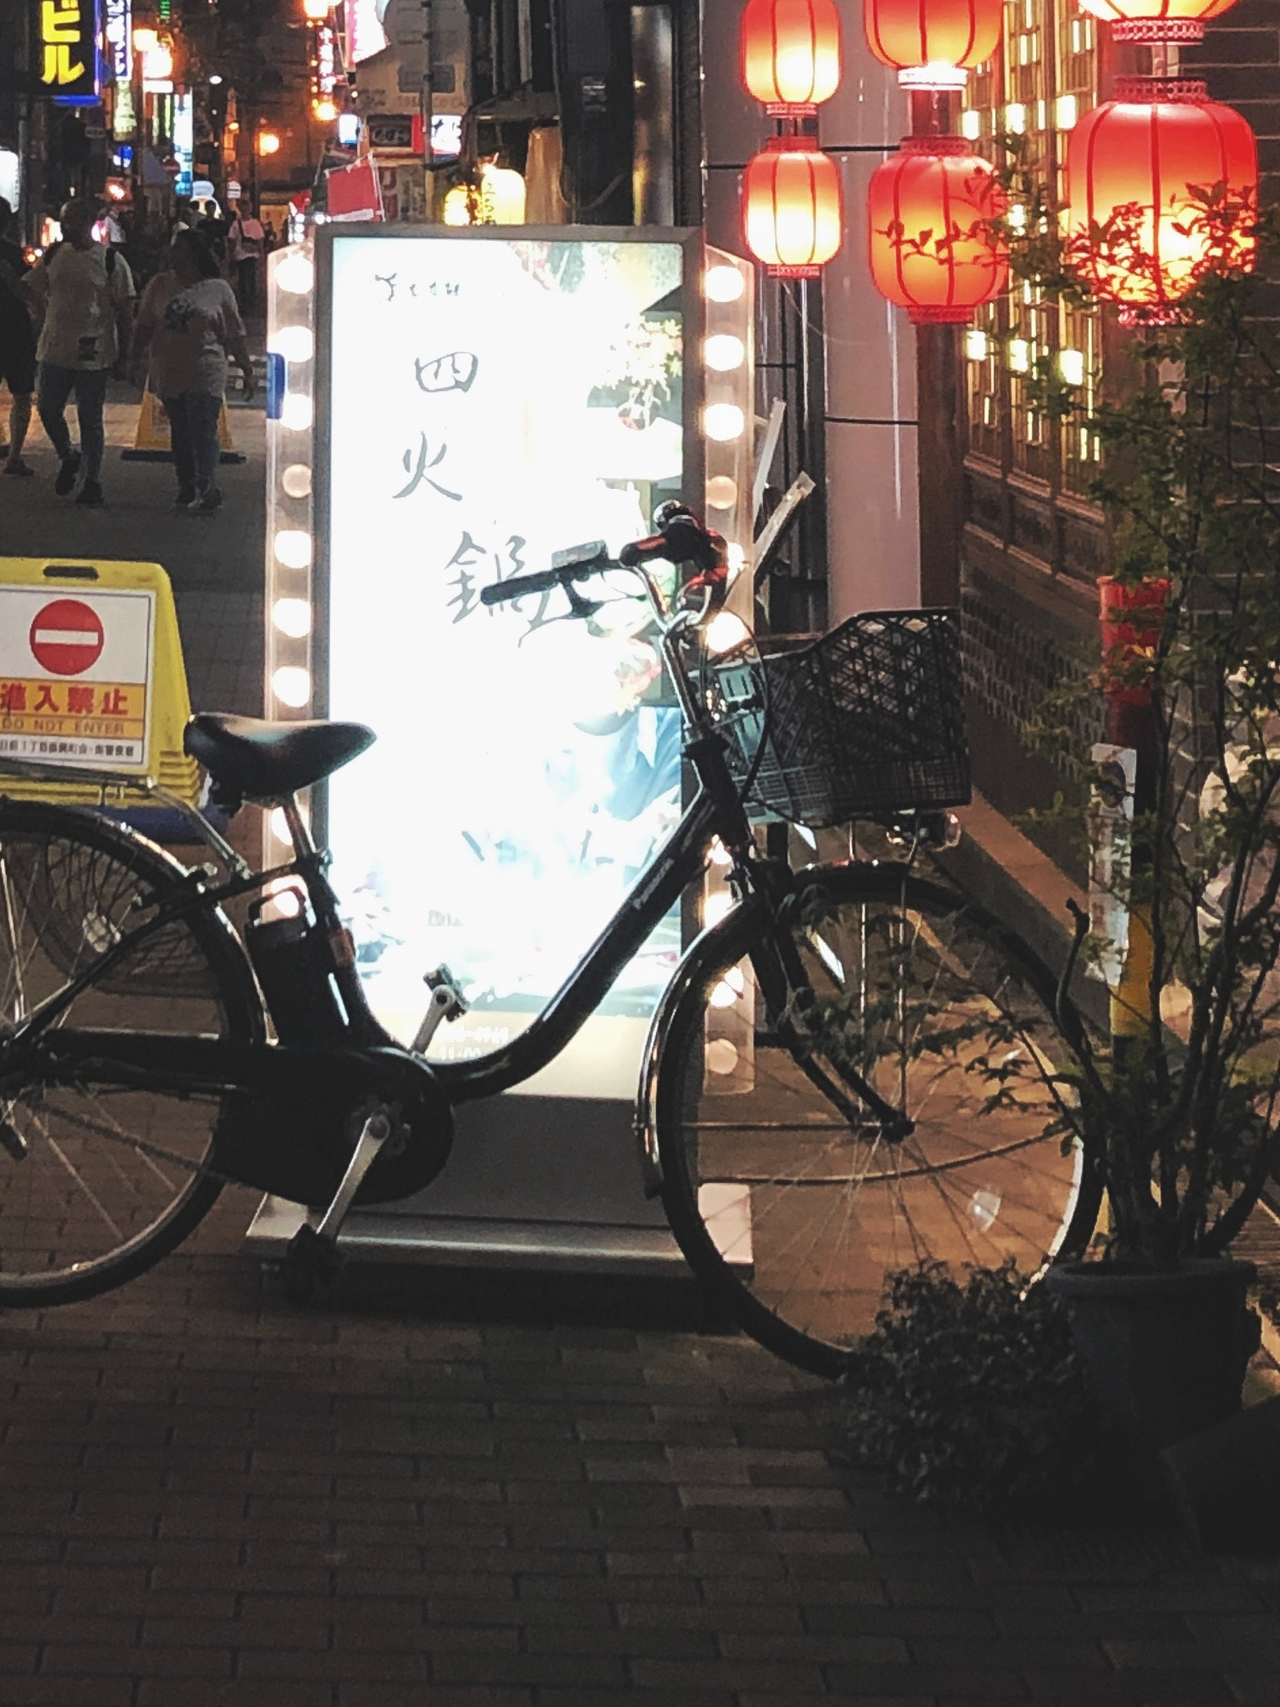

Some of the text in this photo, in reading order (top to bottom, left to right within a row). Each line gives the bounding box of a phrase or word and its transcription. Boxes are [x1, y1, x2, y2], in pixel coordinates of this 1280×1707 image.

[0, 683, 129, 716] 進入禁止
[33, 719, 66, 733] NOT
[74, 722, 125, 735] ENTER
